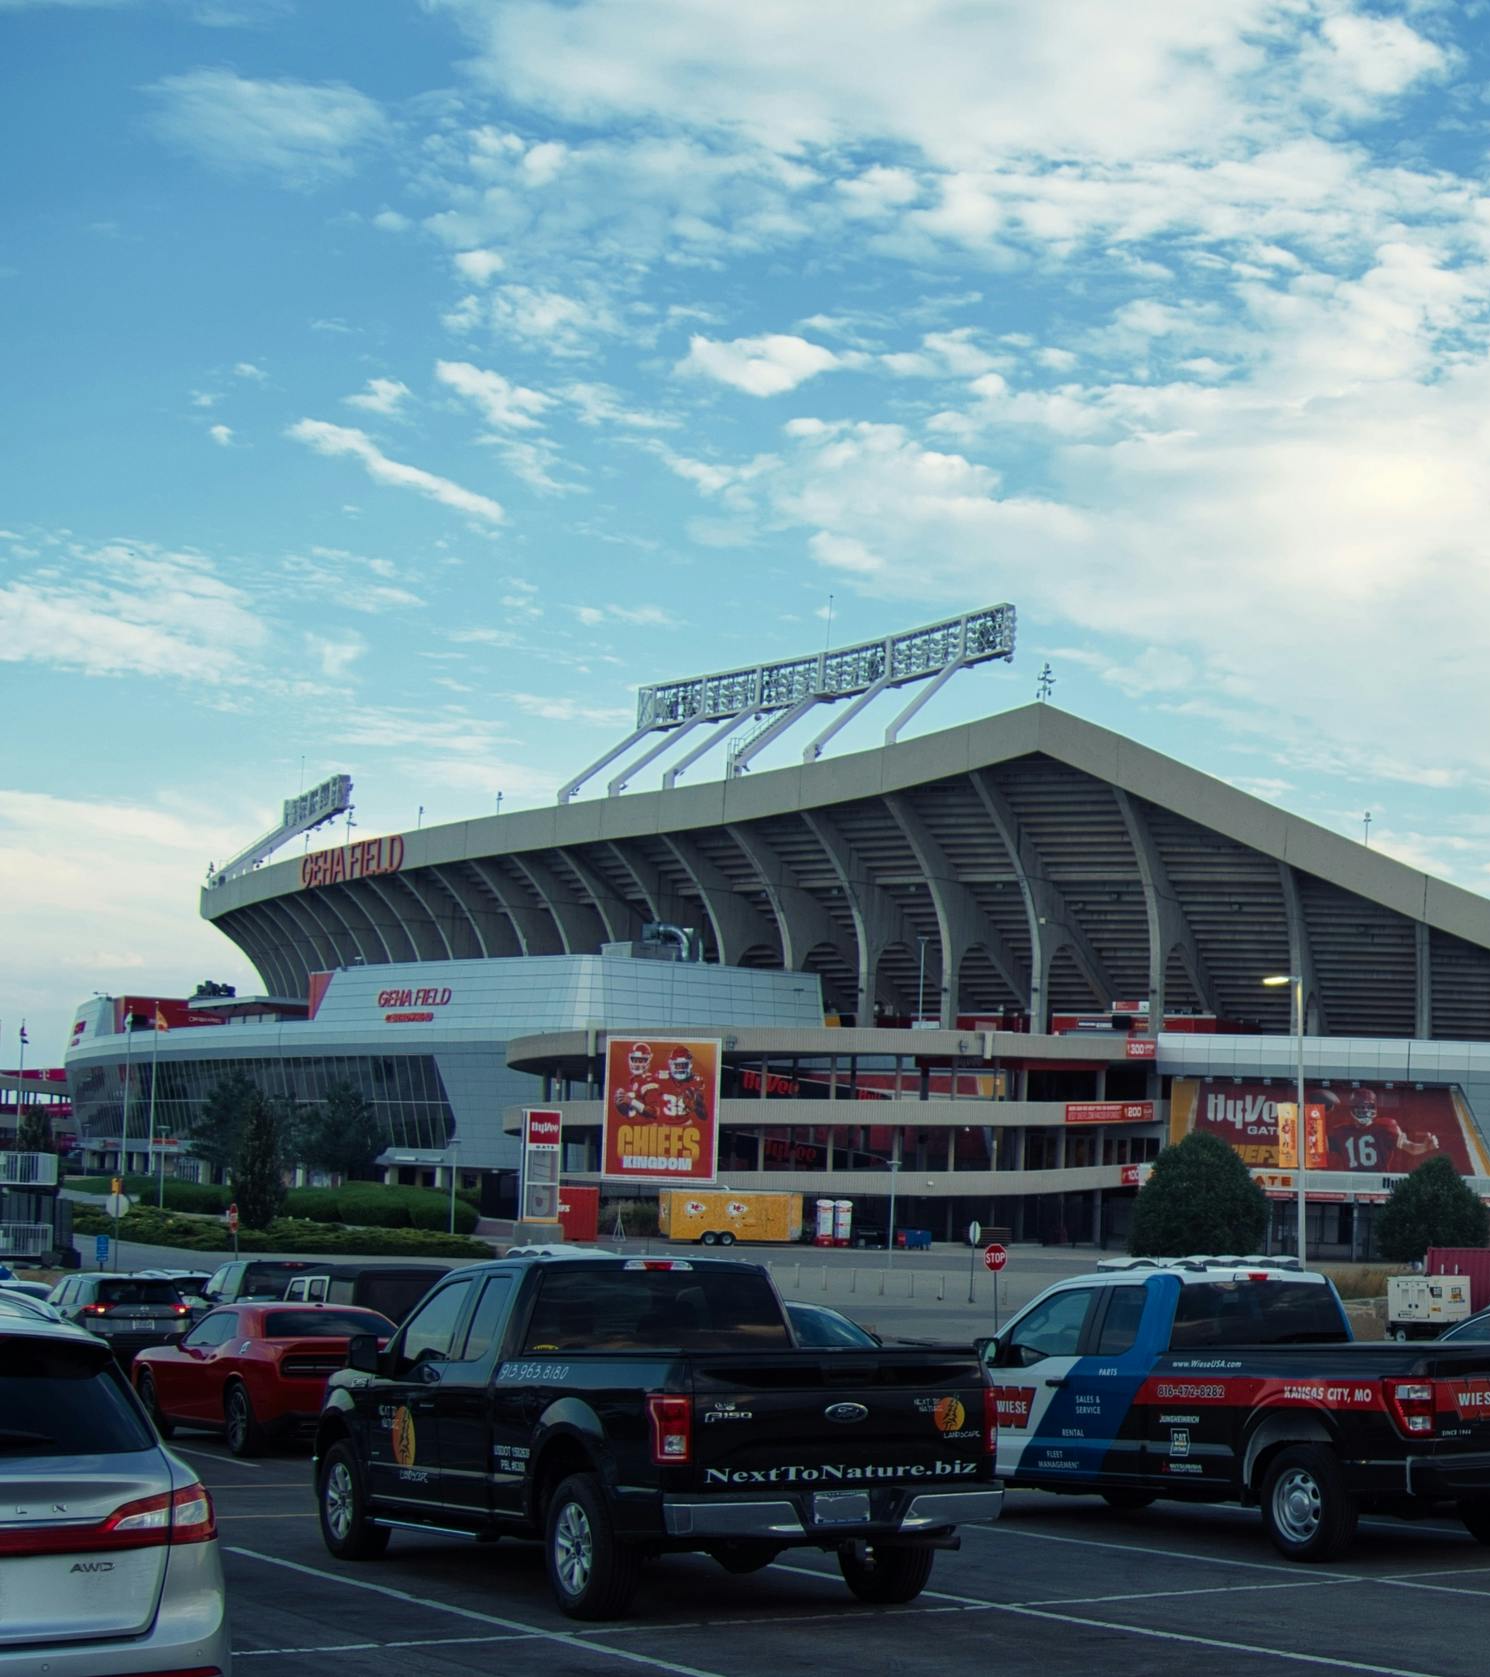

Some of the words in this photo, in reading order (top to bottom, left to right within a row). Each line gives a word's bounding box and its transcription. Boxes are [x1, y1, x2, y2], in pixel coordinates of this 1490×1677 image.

[301, 846, 346, 888] GEHA
[350, 834, 404, 880] FIELD
[379, 988, 412, 1007] GEHA
[414, 987, 452, 1006] FIELD
[1207, 1093, 1280, 1129] HyVe
[531, 1121, 559, 1134] HyVee
[617, 1125, 700, 1161] CHIEFS
[1345, 1135, 1377, 1168] 16
[622, 1155, 692, 1171] KINGDOM
[985, 1252, 1006, 1264] STOP
[500, 1363, 519, 1380] 913
[519, 1362, 541, 1381] 963
[542, 1365, 570, 1380] 8180
[1098, 1368, 1118, 1377] PARTS
[1157, 1384, 1225, 1399] 816-472-8282
[1284, 1385, 1324, 1400] KANSAS
[1327, 1387, 1351, 1403] CITY,
[1354, 1388, 1373, 1403] MO
[996, 1400, 1028, 1414] WIESE
[1075, 1395, 1094, 1404] SALES
[1075, 1406, 1101, 1415] SERVICE
[1062, 1428, 1084, 1437] RENTAL
[1046, 1450, 1063, 1459] FLEET
[704, 1459, 978, 1484] NextToNature.biz
[70, 1562, 115, 1573] AWD
